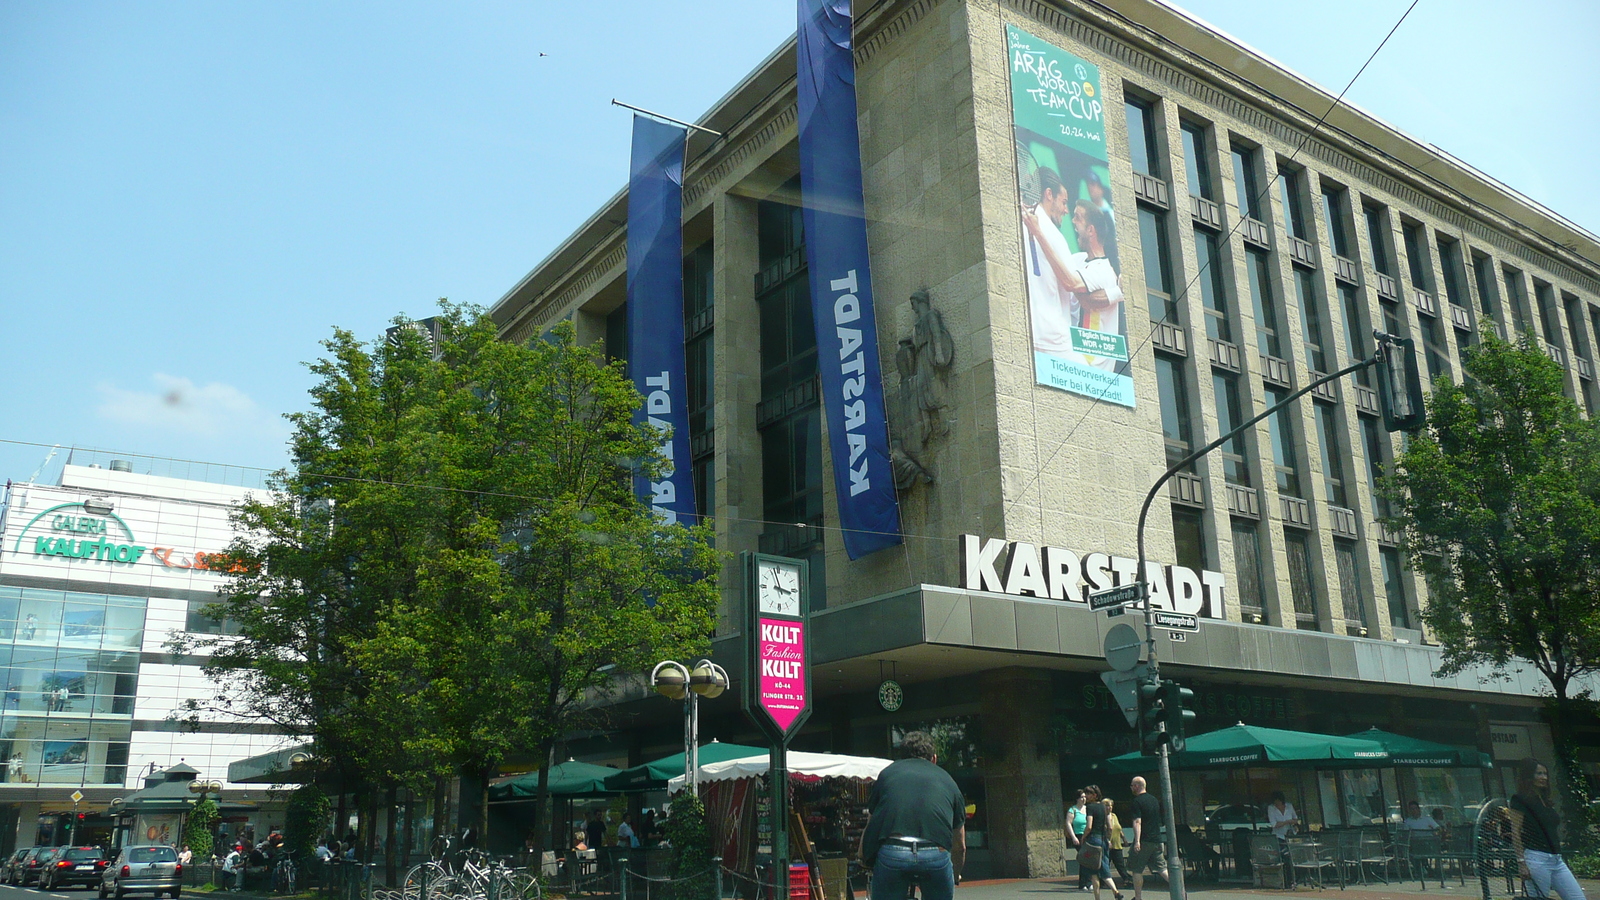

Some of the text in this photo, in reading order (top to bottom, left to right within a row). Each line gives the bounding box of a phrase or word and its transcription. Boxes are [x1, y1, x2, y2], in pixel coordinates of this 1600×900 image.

[1010, 32, 1018, 40] 30
[1014, 50, 1062, 78] ARAG
[1037, 76, 1082, 98] WORLD
[1026, 88, 1102, 122] TEAM CUP
[1078, 329, 1100, 340] Täglich
[1100, 334, 1110, 342] live
[1082, 339, 1098, 348] WDR
[1050, 358, 1120, 387] Ticketvorverkauf
[1051, 374, 1122, 402] hier bei Karstadt!
[52, 514, 108, 535] GALERIA
[960, 534, 1224, 618] KARSTADT
[1093, 588, 1135, 606] Schadowstraße
[762, 624, 800, 645] KULT
[763, 644, 802, 660] Fashion
[762, 659, 802, 679] KULT
[1224, 693, 1298, 720] COFFEE
[1209, 756, 1240, 764] STARBUCKS
